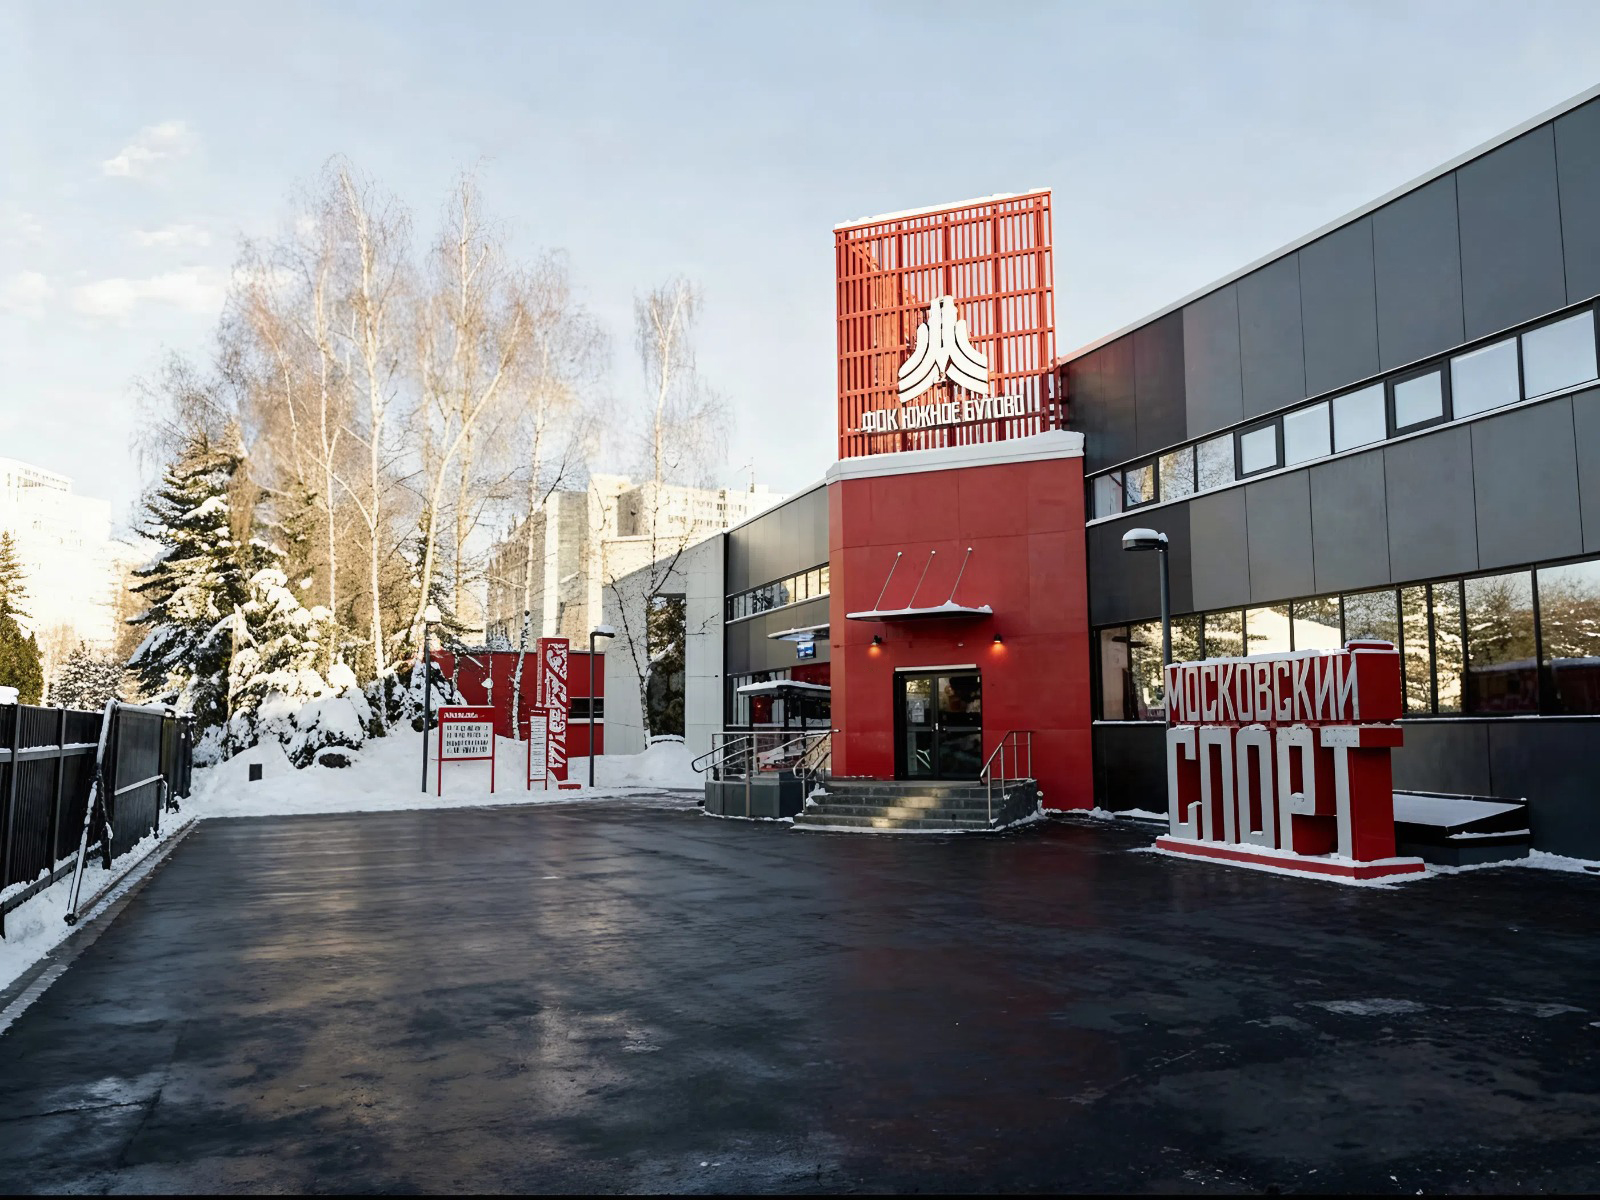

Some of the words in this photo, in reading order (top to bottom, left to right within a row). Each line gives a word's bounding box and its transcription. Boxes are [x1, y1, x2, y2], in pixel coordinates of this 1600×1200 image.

[862, 409, 898, 433] ФОК
[901, 401, 961, 429] ЮЖНОЕ
[964, 394, 1025, 422] БУТОВО
[1166, 724, 1360, 860] СПОРТ
